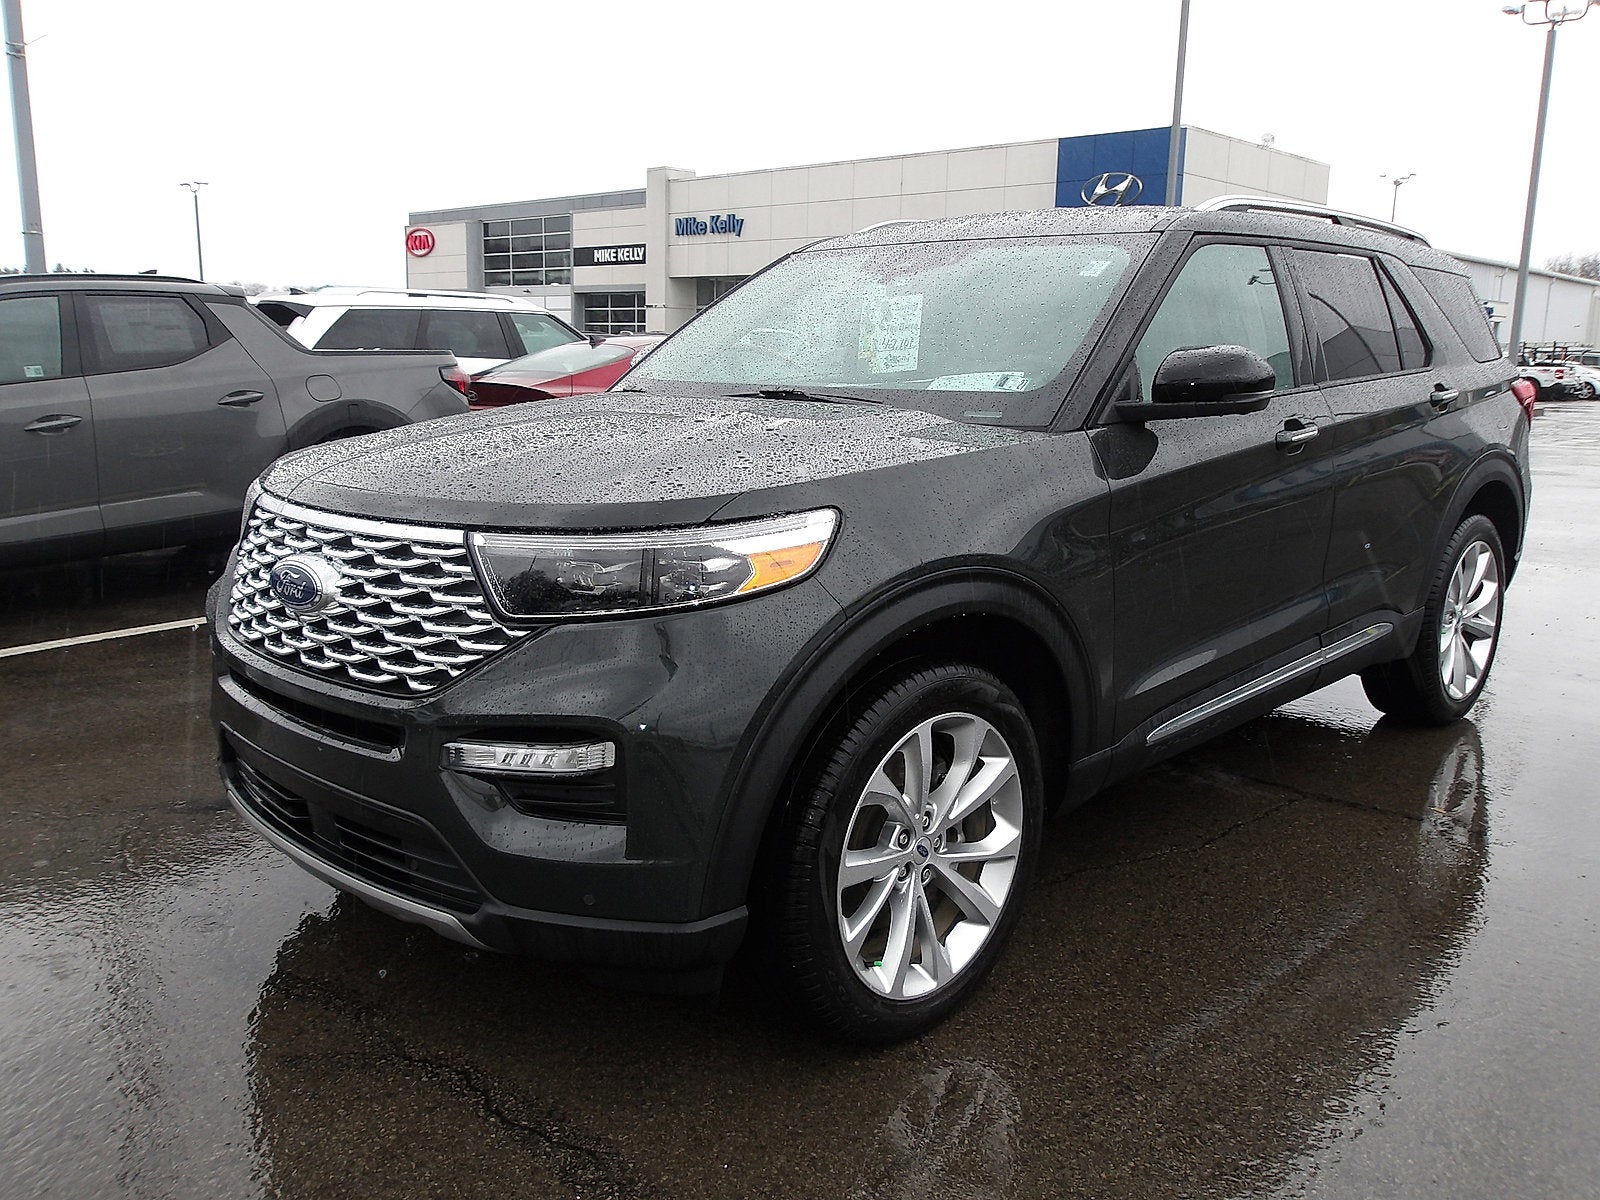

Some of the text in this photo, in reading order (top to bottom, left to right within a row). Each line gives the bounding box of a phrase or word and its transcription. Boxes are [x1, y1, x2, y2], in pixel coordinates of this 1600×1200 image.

[675, 214, 744, 237] Mike Kelly
[408, 234, 431, 250] KIA
[593, 247, 645, 263] MIKE KELLY
[276, 569, 307, 599] Ford
